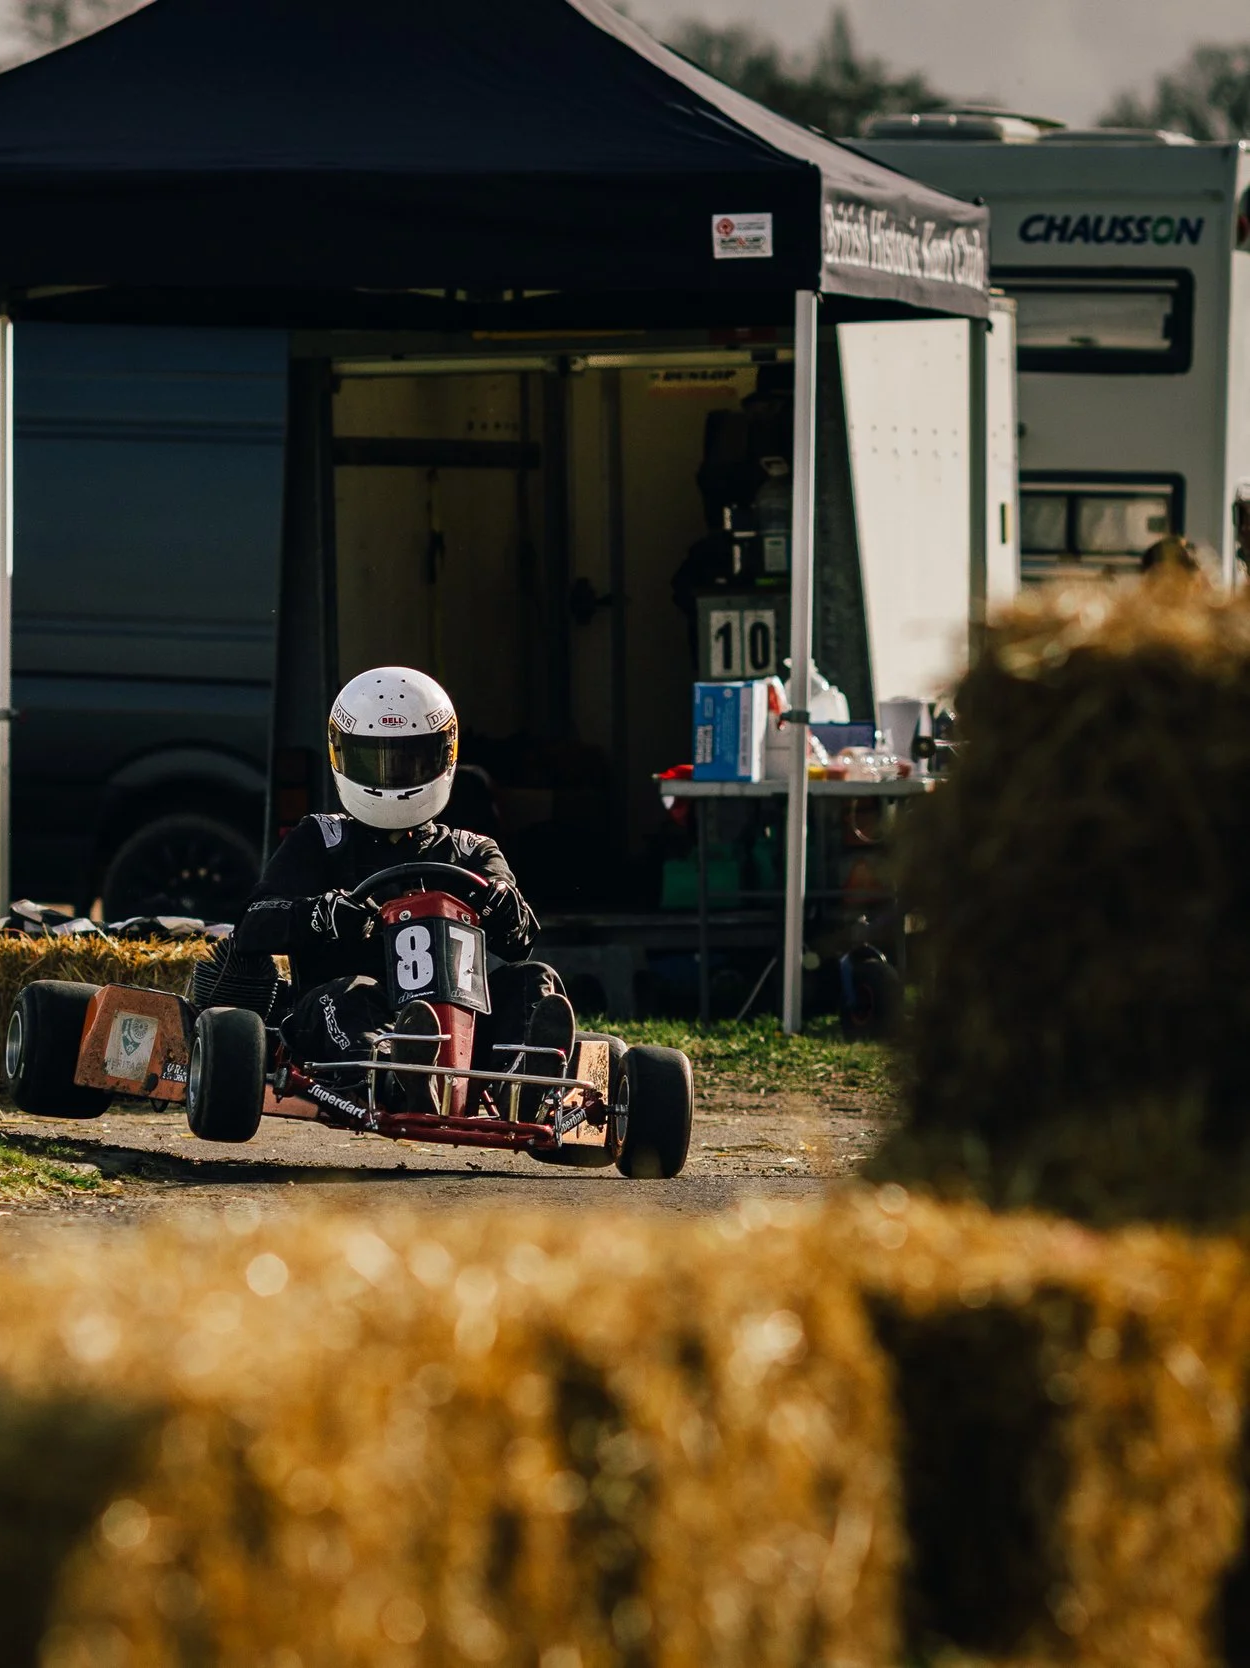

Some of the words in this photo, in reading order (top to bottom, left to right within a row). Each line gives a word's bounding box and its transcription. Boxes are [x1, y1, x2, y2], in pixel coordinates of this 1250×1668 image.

[824, 203, 869, 266] British
[870, 209, 922, 278] Historic
[1018, 213, 1205, 246] CHAUSSON
[714, 620, 771, 671] 10
[307, 1084, 366, 1119] Superdart
